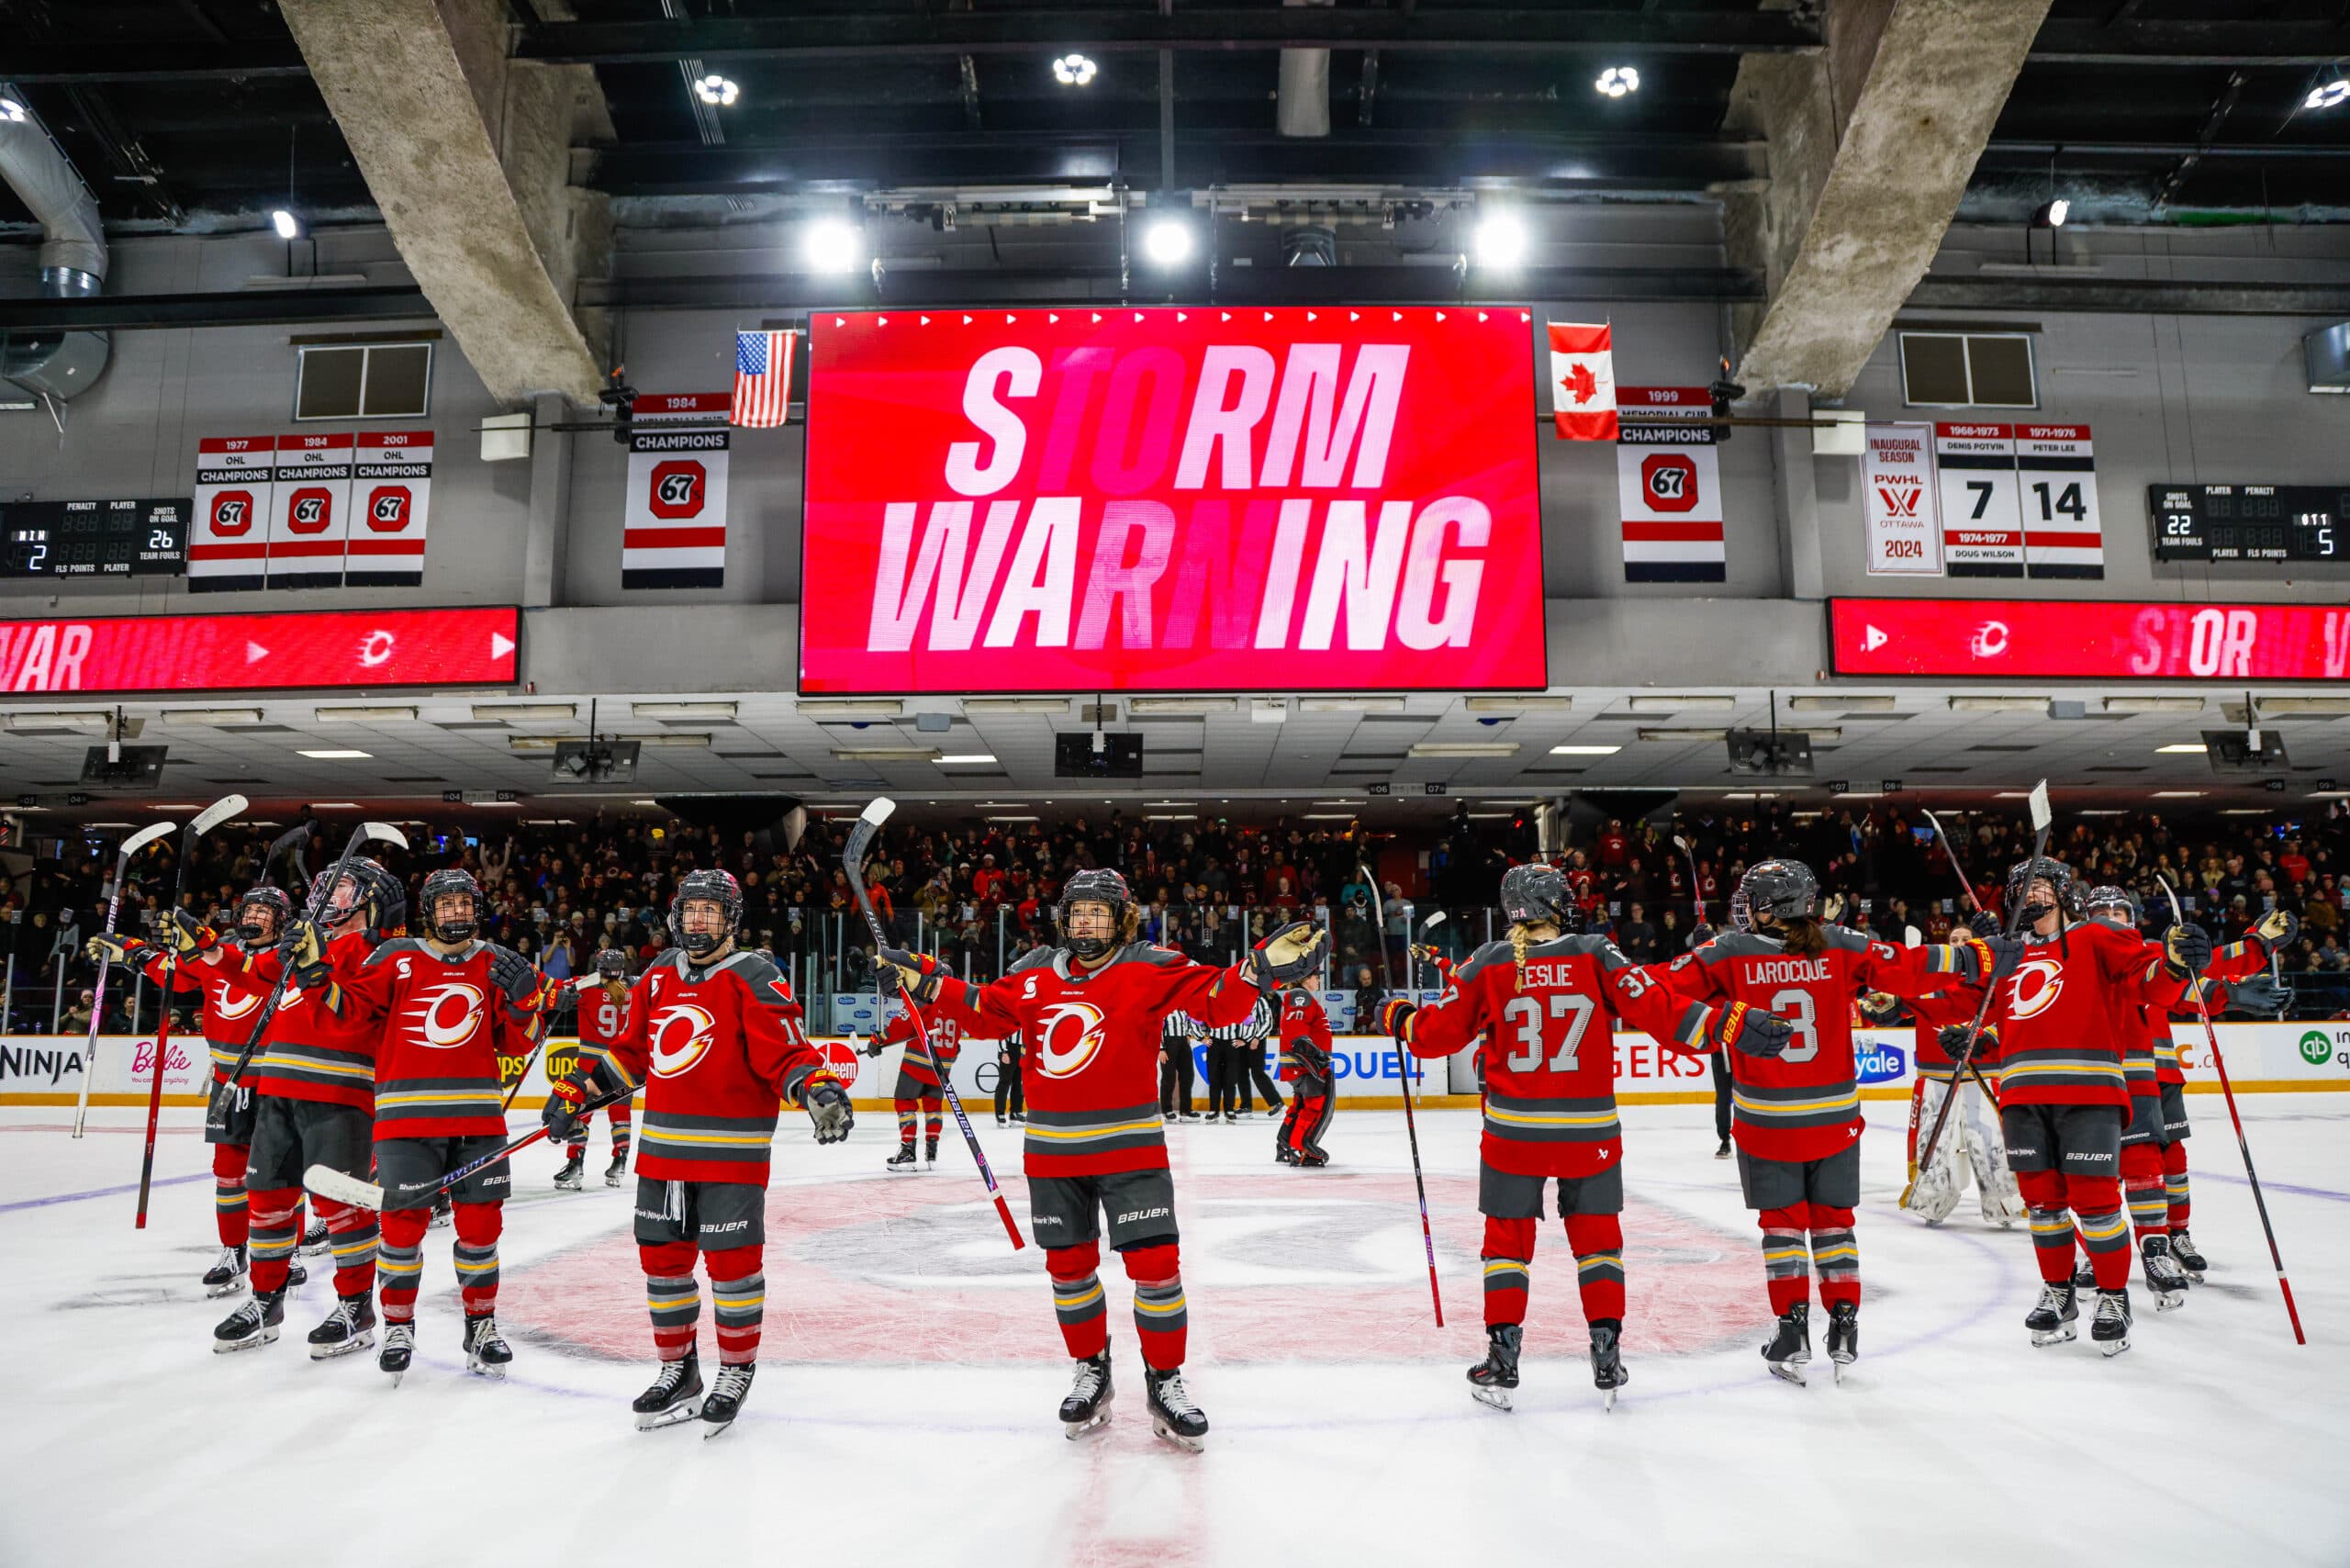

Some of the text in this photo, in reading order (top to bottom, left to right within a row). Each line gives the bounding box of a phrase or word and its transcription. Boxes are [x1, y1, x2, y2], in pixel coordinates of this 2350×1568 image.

[1648, 390, 1679, 402] 1999
[666, 397, 697, 409] 1984
[945, 343, 1410, 496] STORM
[304, 437, 328, 447] 1984
[383, 435, 408, 445] 2001
[635, 434, 724, 449] CHAMPIONS
[1622, 429, 1711, 442] CHAMPIONS
[226, 441, 249, 450] 1977
[1870, 438, 1922, 452] INAUGURAL
[1946, 442, 2004, 451] DENIS POTVIN
[2033, 443, 2076, 453] PETER LEE
[225, 455, 246, 465] OHL
[304, 453, 324, 463] OHL
[383, 451, 404, 461] OHL
[1879, 452, 1915, 464] SEASON
[201, 469, 268, 483] CHAMPIONS
[278, 466, 347, 480] CHAMPIONS
[358, 465, 427, 477] CHAMPIONS
[1874, 475, 1923, 486] PWHL
[2206, 487, 2275, 495] PLAYER PENALTY
[67, 501, 136, 510] PENALTY PLAYER
[1966, 480, 1993, 520] 7
[2032, 481, 2087, 521] 14
[153, 507, 175, 515] SHOTS
[161, 514, 178, 522] GOAL
[1879, 520, 1924, 529] OTTAWA
[2167, 515, 2191, 535] 22
[149, 530, 173, 548] 26
[1958, 533, 2008, 544] 1974-1977
[2162, 537, 2202, 546] TEAM FOULS
[2319, 529, 2333, 555] 5
[140, 551, 181, 560] TEAM FOULS
[1885, 540, 1923, 558] 2024
[1954, 550, 2015, 558] DOUG WILSON
[2212, 549, 2287, 558] PLAYER FLS POINTS
[29, 544, 47, 570] 2
[55, 564, 129, 573] FLS POINTS PLAYER
[867, 496, 1492, 652] WARNING
[1745, 958, 1831, 985] LAROCQUE
[1617, 966, 1656, 999] 37
[597, 1004, 632, 1038] 97
[1771, 989, 1819, 1063] 3
[934, 1017, 957, 1048] 29
[1504, 994, 1596, 1073] 37
[132, 1042, 192, 1073] Babie
[819, 1043, 857, 1080] heem
[0, 1044, 84, 1086] NINJA
[1263, 1051, 1426, 1080] FDUEL
[946, 1092, 974, 1138] BAUER
[2065, 1152, 2113, 1162] BAUER
[1117, 1207, 1169, 1225] BAUER
[699, 1220, 748, 1233] BAUER
